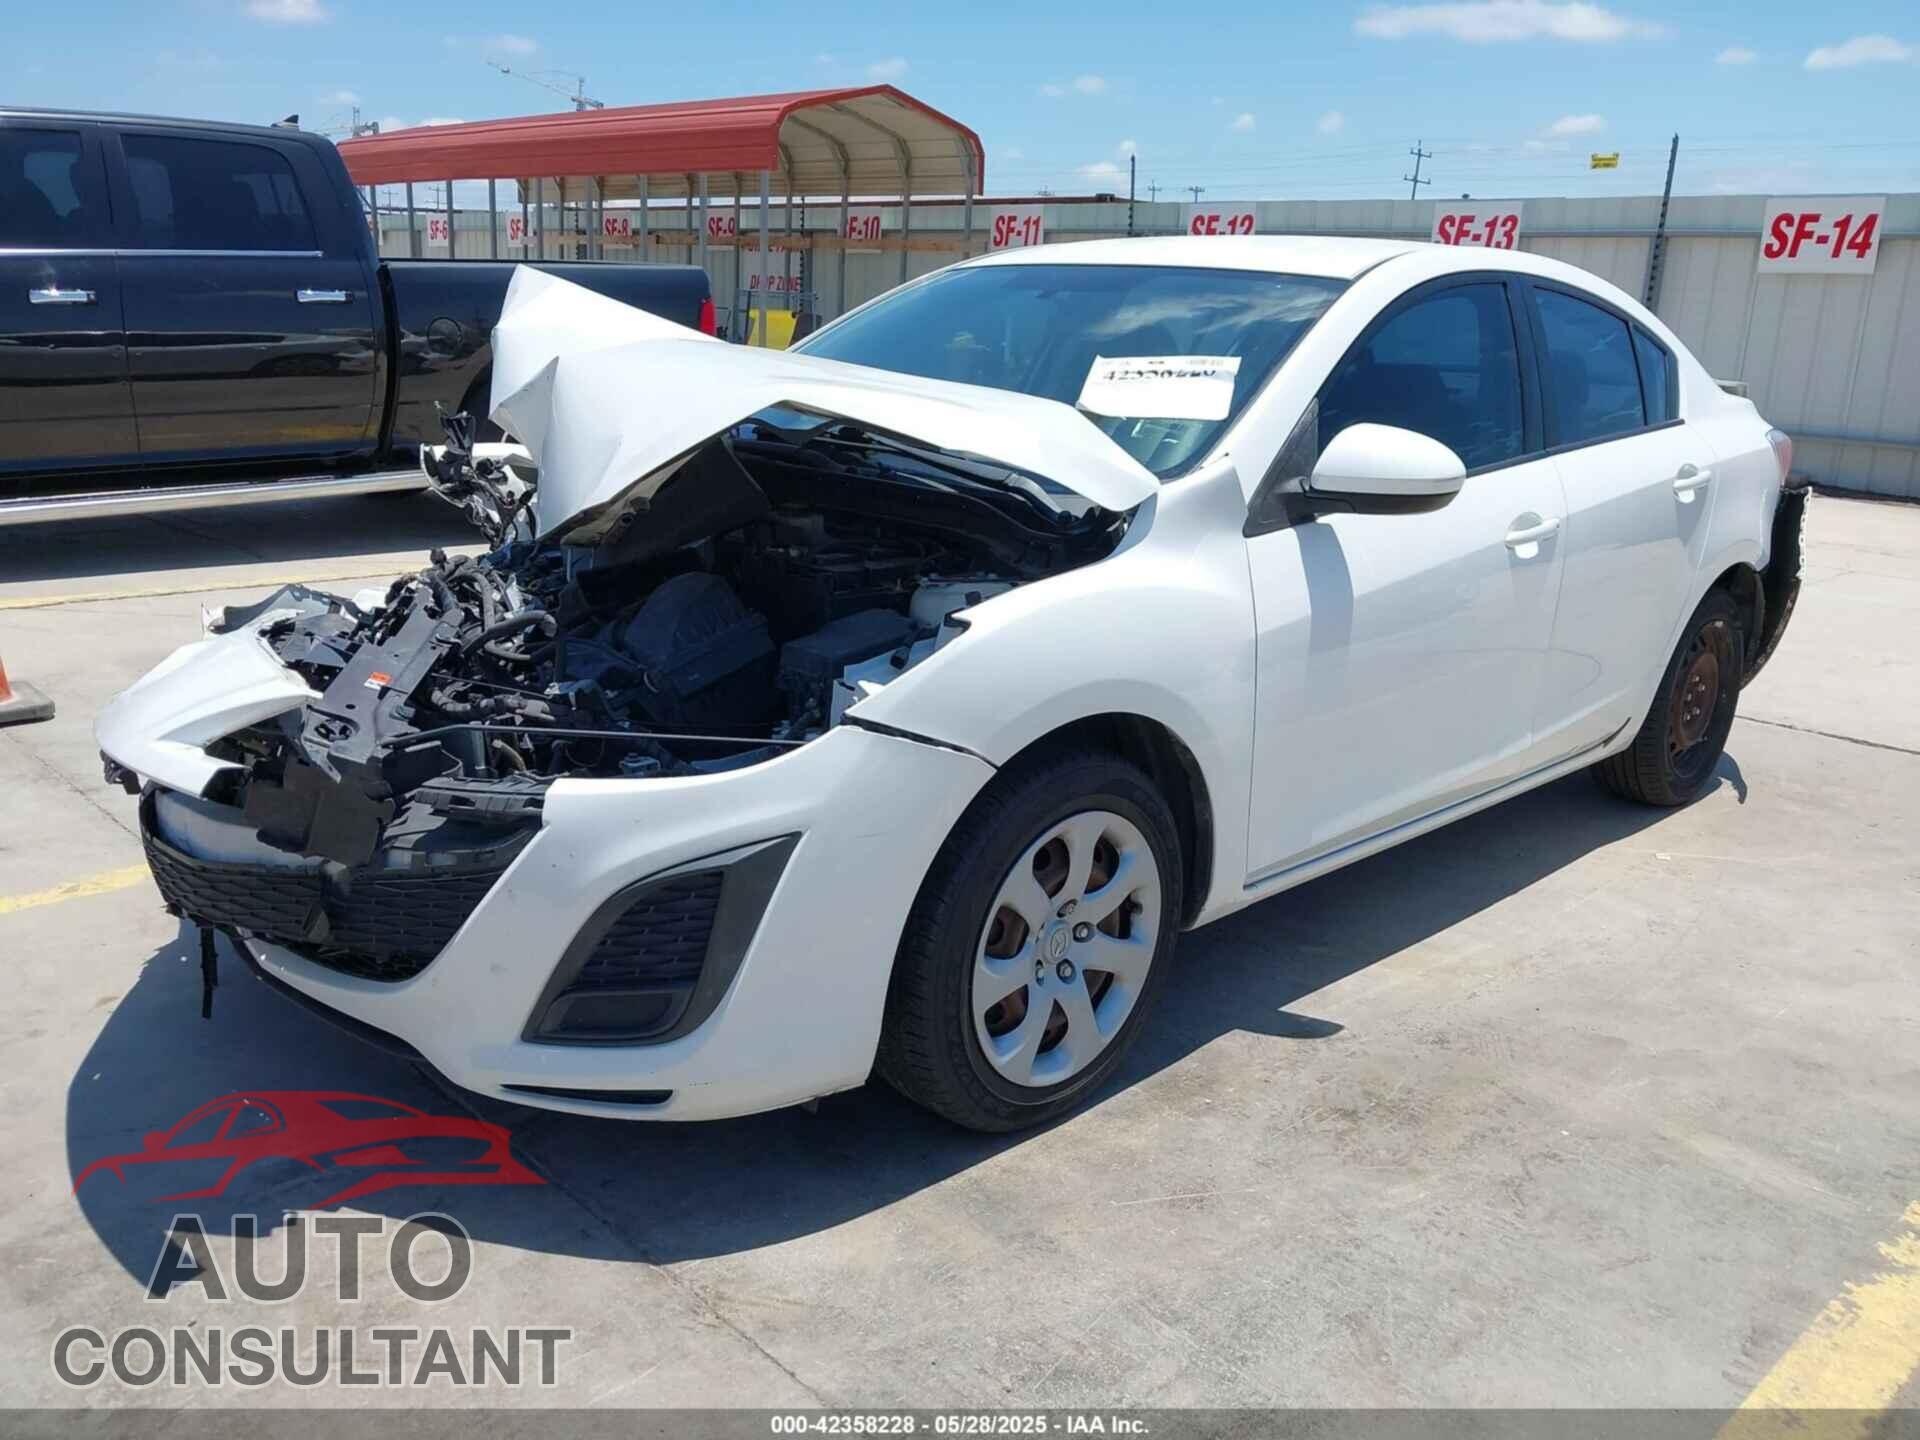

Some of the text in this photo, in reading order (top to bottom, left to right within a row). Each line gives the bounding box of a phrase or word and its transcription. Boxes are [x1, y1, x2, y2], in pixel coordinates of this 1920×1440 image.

[847, 216, 880, 240] F-10
[993, 210, 1041, 247] SF-11
[1191, 214, 1254, 235] SF-12
[1438, 214, 1519, 250] SF-13
[1763, 212, 1879, 260] SF-14
